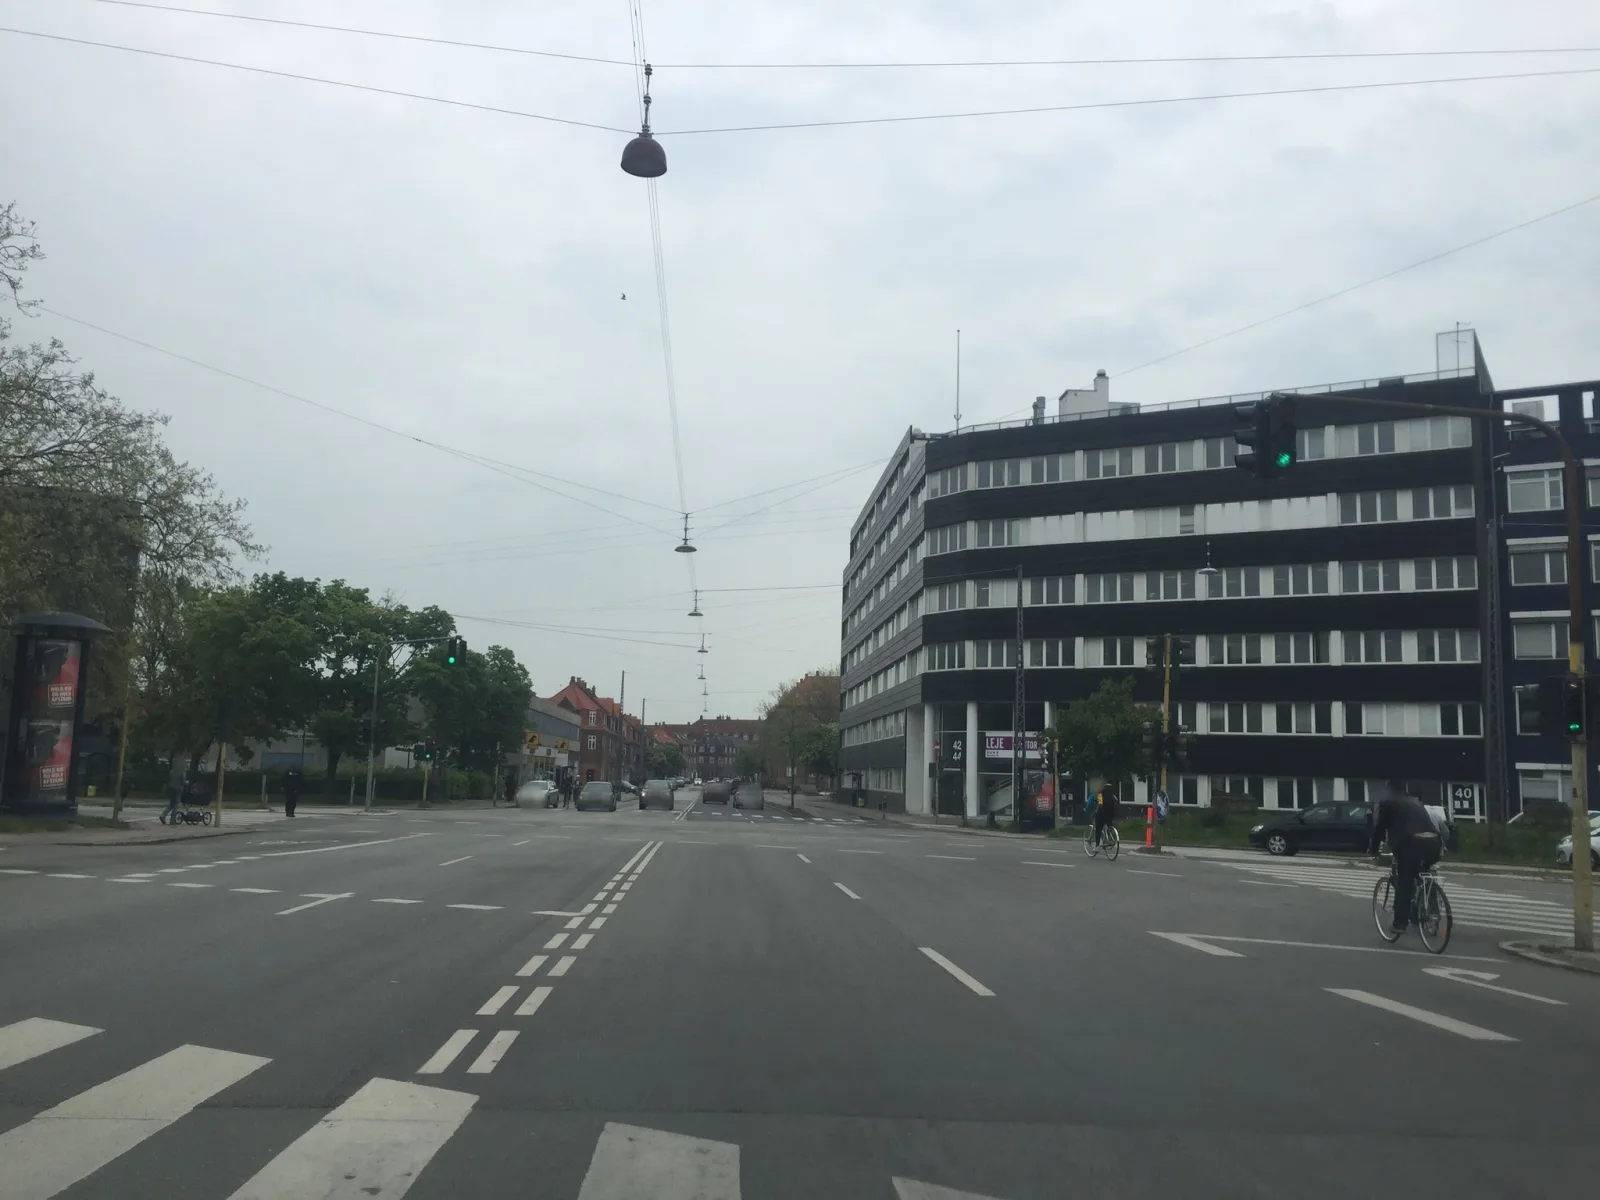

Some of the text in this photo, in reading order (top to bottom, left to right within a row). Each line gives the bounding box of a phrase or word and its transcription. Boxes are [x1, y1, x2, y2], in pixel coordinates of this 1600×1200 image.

[953, 740, 962, 750] 42
[986, 737, 1004, 749] LEJE
[952, 751, 962, 761] 44
[1455, 788, 1472, 798] 40
